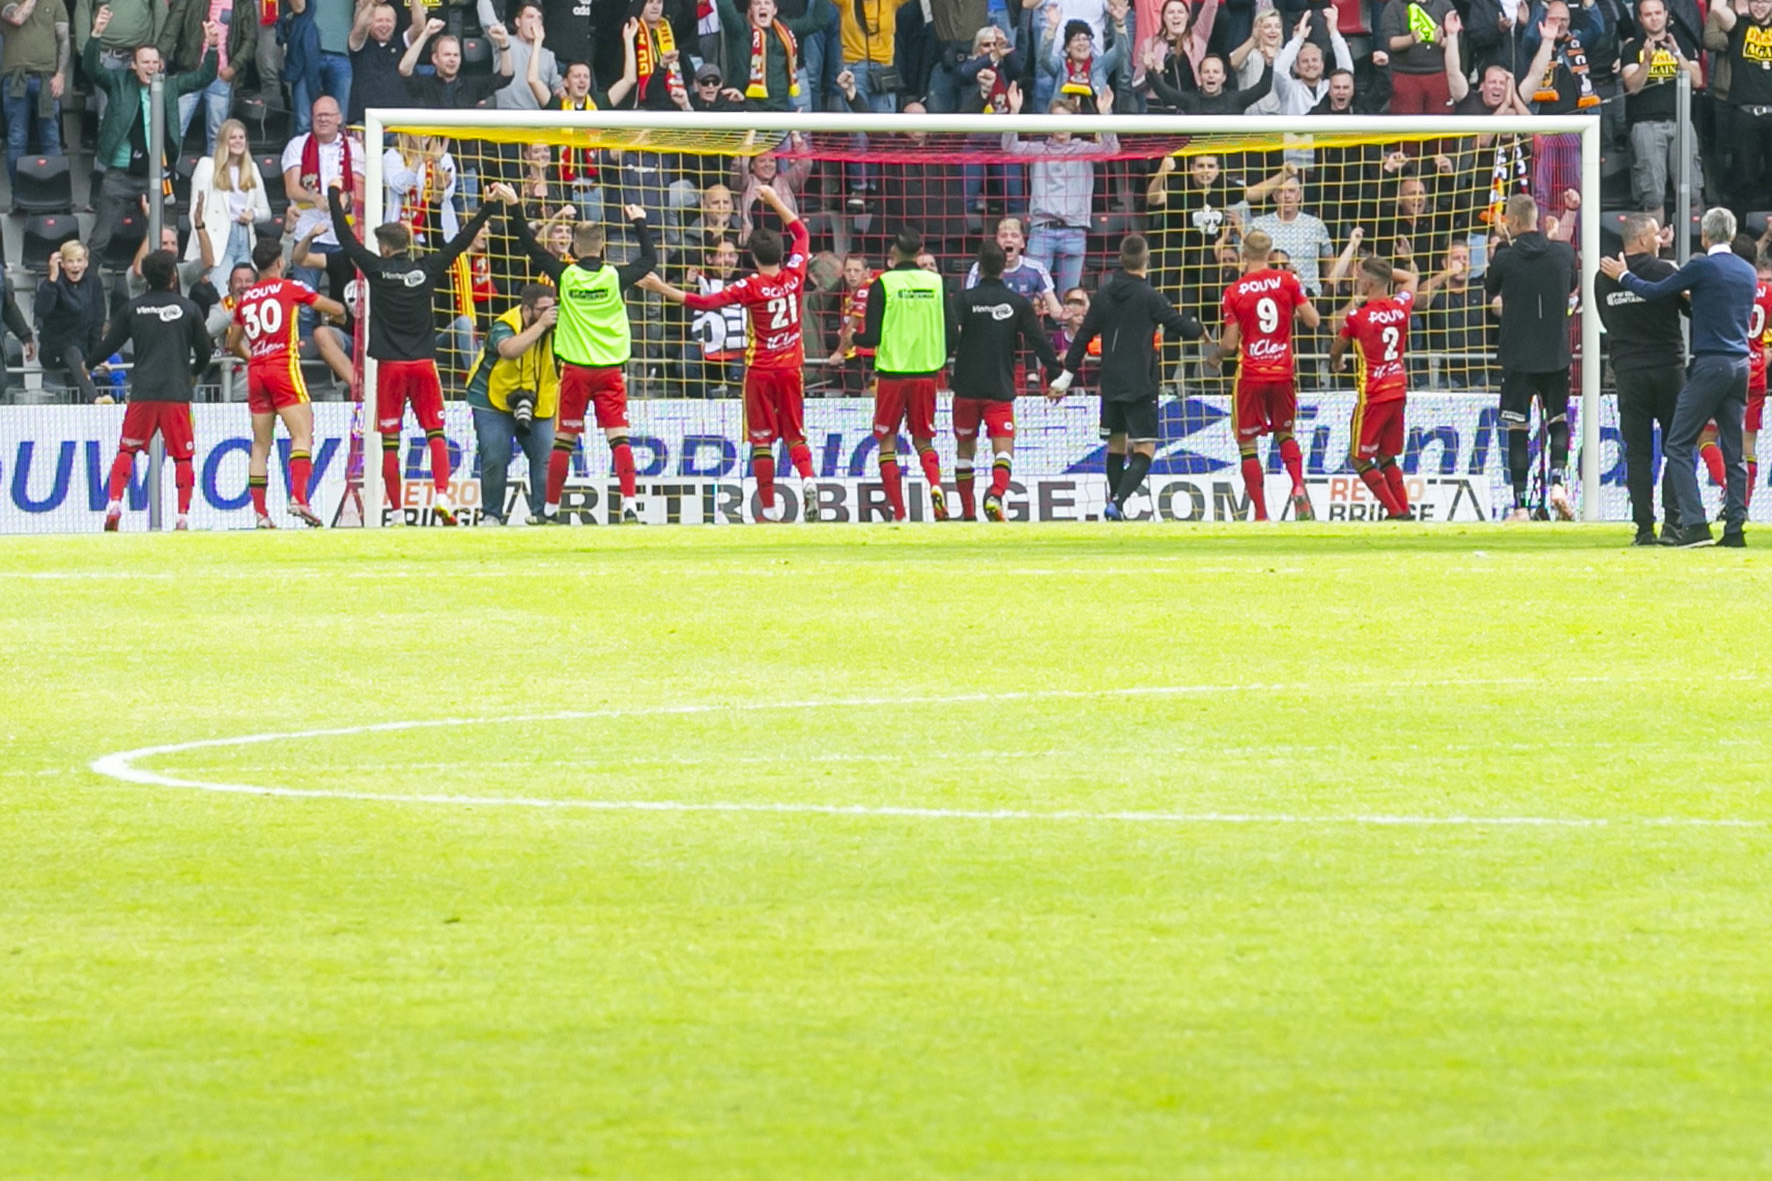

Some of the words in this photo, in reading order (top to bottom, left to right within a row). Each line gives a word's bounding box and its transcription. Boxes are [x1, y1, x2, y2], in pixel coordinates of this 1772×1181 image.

[243, 282, 283, 301] POUW
[1240, 276, 1282, 294] POUW
[242, 297, 283, 340] 30
[766, 294, 799, 331] 21
[1256, 297, 1279, 335] 9
[1370, 309, 1405, 325] POUW
[1381, 325, 1400, 362] 2
[0, 440, 166, 513] UW
[383, 482, 479, 508] ETRO
[1329, 478, 1425, 502] REO
[1329, 503, 1436, 522] BRIGE
